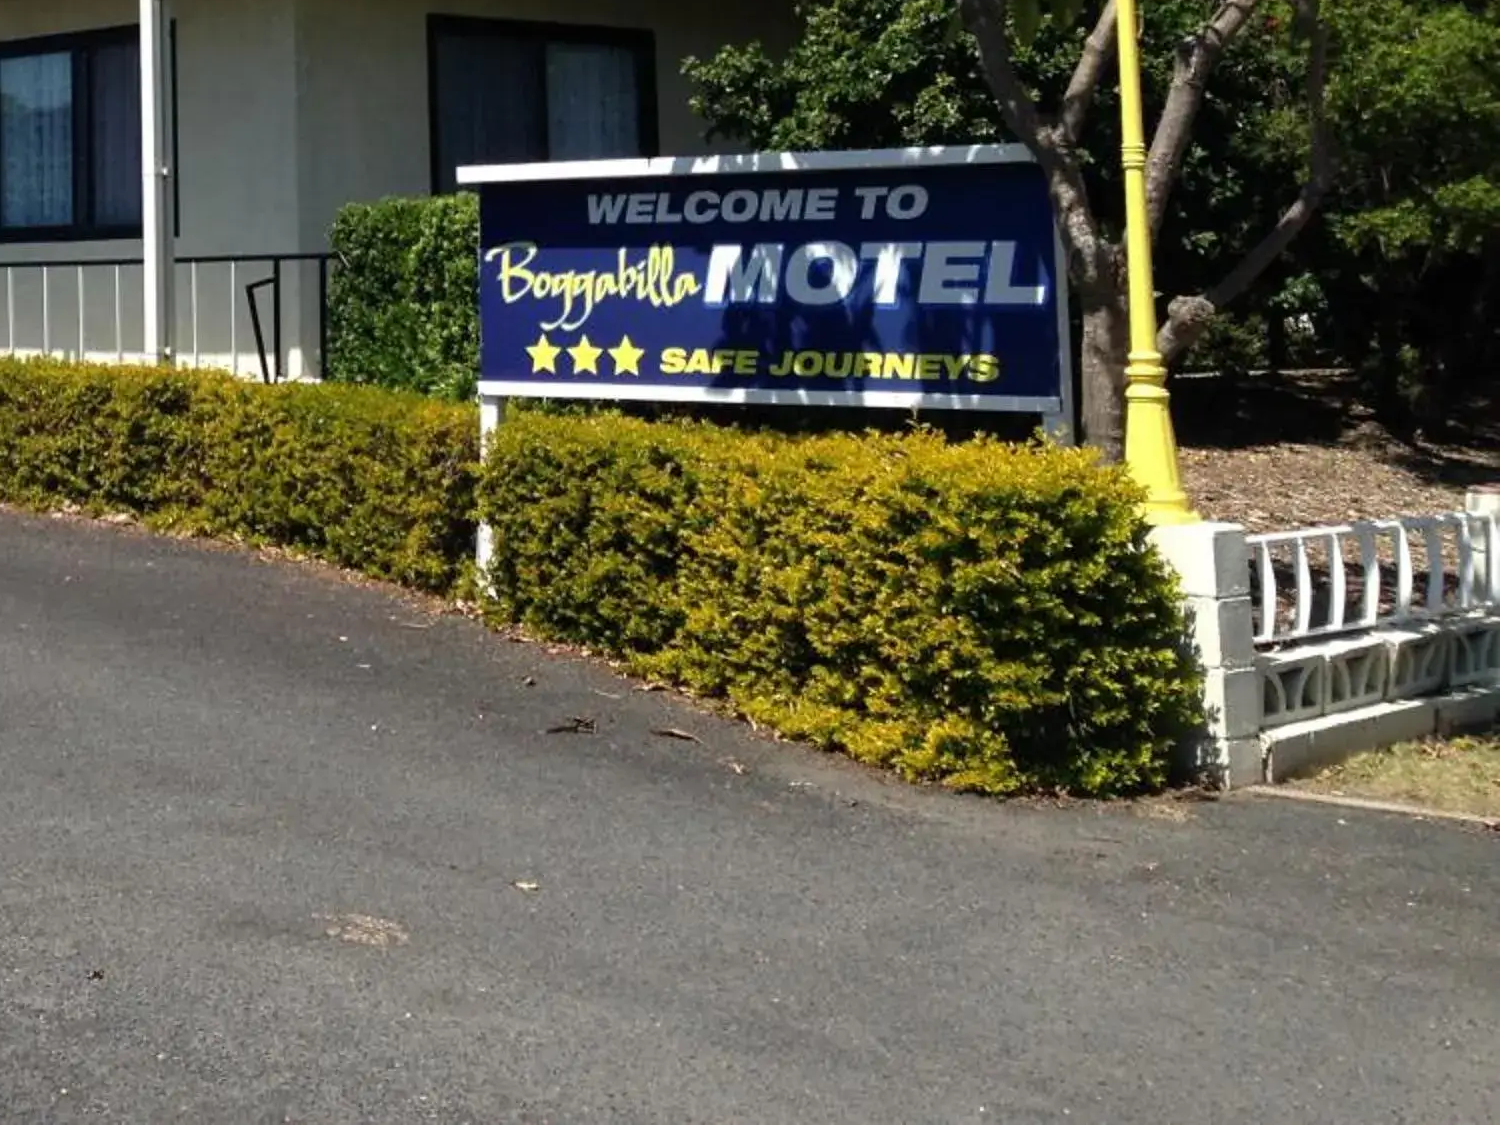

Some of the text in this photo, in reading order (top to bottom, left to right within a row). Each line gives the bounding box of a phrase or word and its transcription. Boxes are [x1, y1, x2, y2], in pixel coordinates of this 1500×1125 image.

[587, 186, 929, 225] WELCOME TO
[485, 241, 1046, 331] Boggabilla MOTEL
[659, 349, 1000, 382] SAFE JOURNEYS
